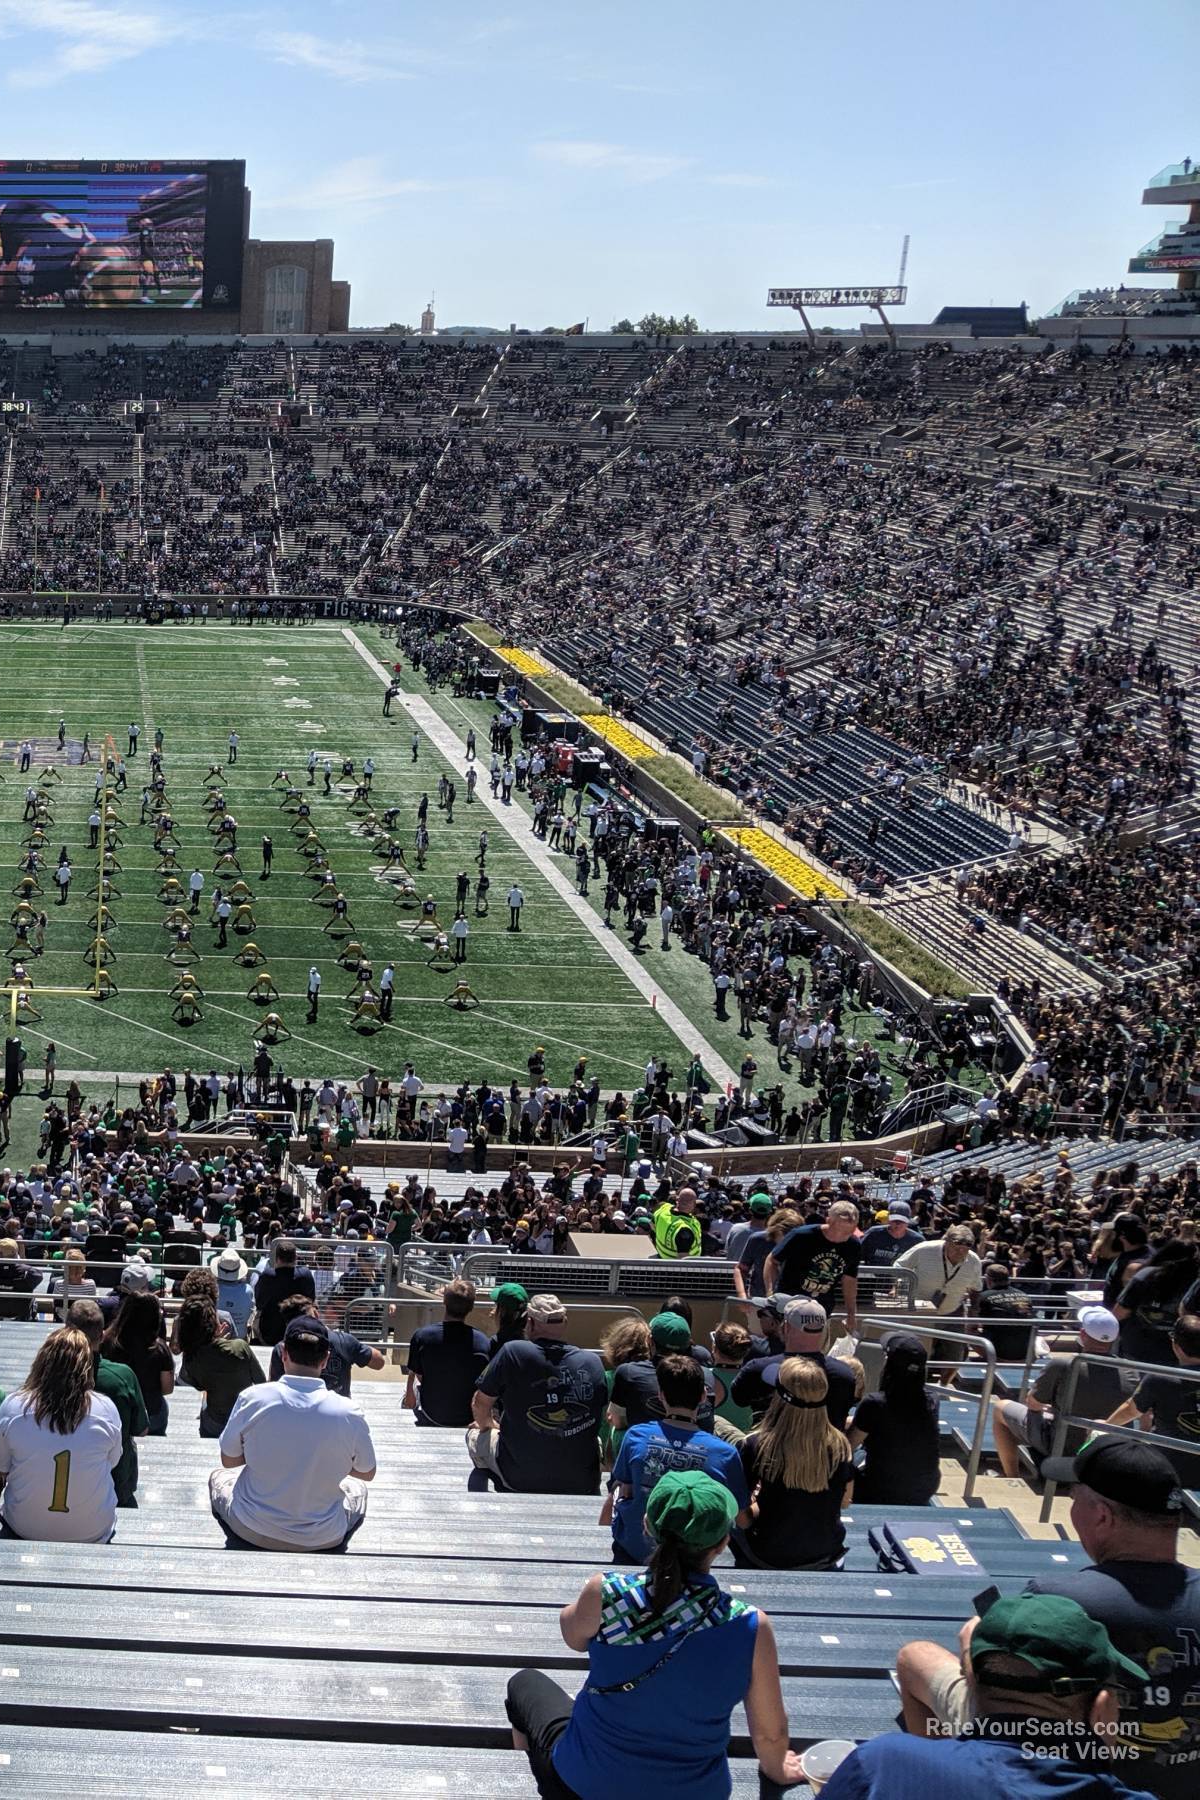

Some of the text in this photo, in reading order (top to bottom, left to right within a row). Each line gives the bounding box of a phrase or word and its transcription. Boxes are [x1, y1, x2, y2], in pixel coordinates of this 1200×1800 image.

[2, 402, 25, 412] 38:43
[131, 402, 143, 412] 25
[221, 1224, 231, 1241] 3
[801, 1314, 825, 1325] IRISH
[547, 1393, 558, 1404] 19
[48, 1449, 71, 1513] 1
[937, 1532, 978, 1567] IRISH
[1143, 1686, 1171, 1706] 19
